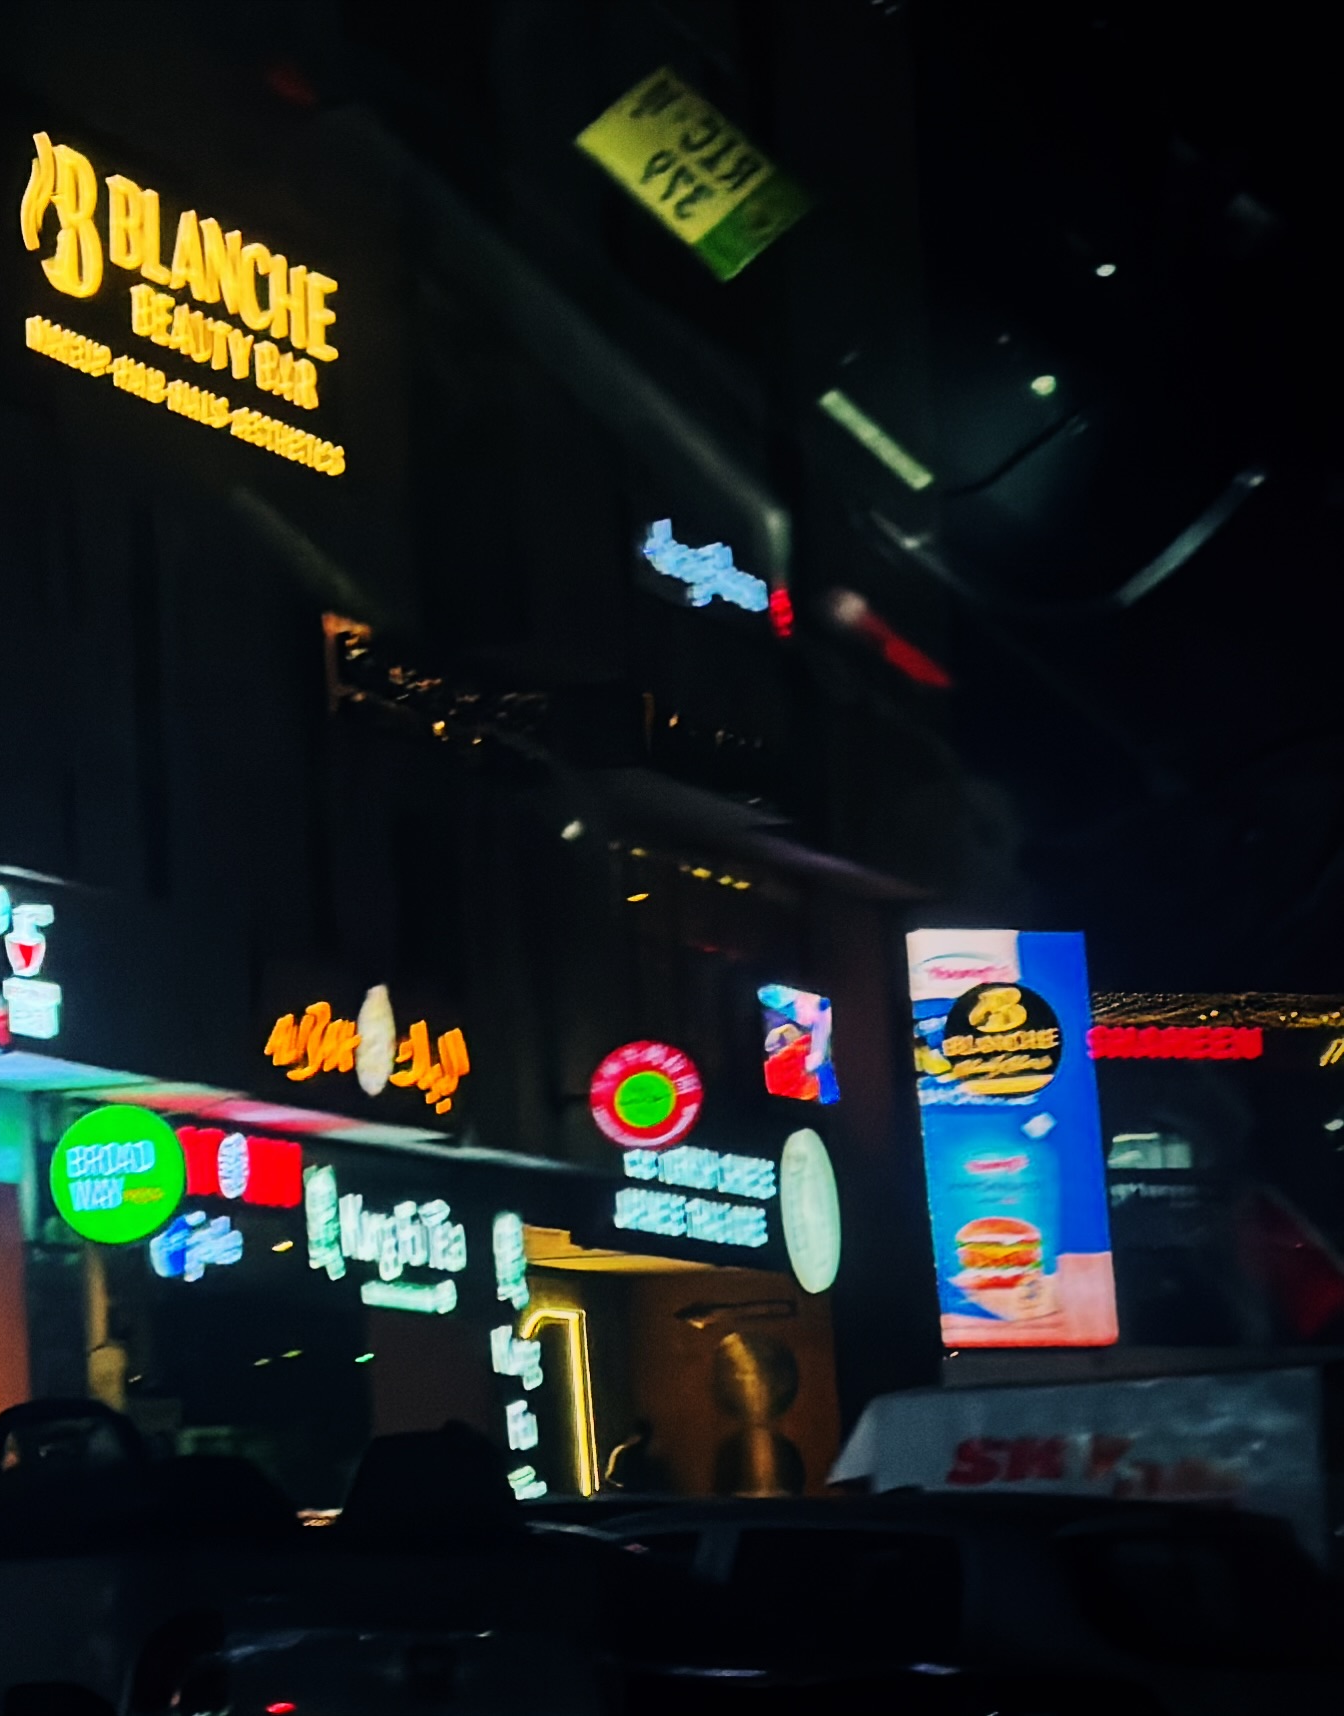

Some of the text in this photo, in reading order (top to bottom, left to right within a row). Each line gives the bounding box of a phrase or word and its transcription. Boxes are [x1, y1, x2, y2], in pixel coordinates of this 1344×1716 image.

[105, 173, 339, 362] BLANCHE
[130, 283, 319, 410] BEAUTY BAR
